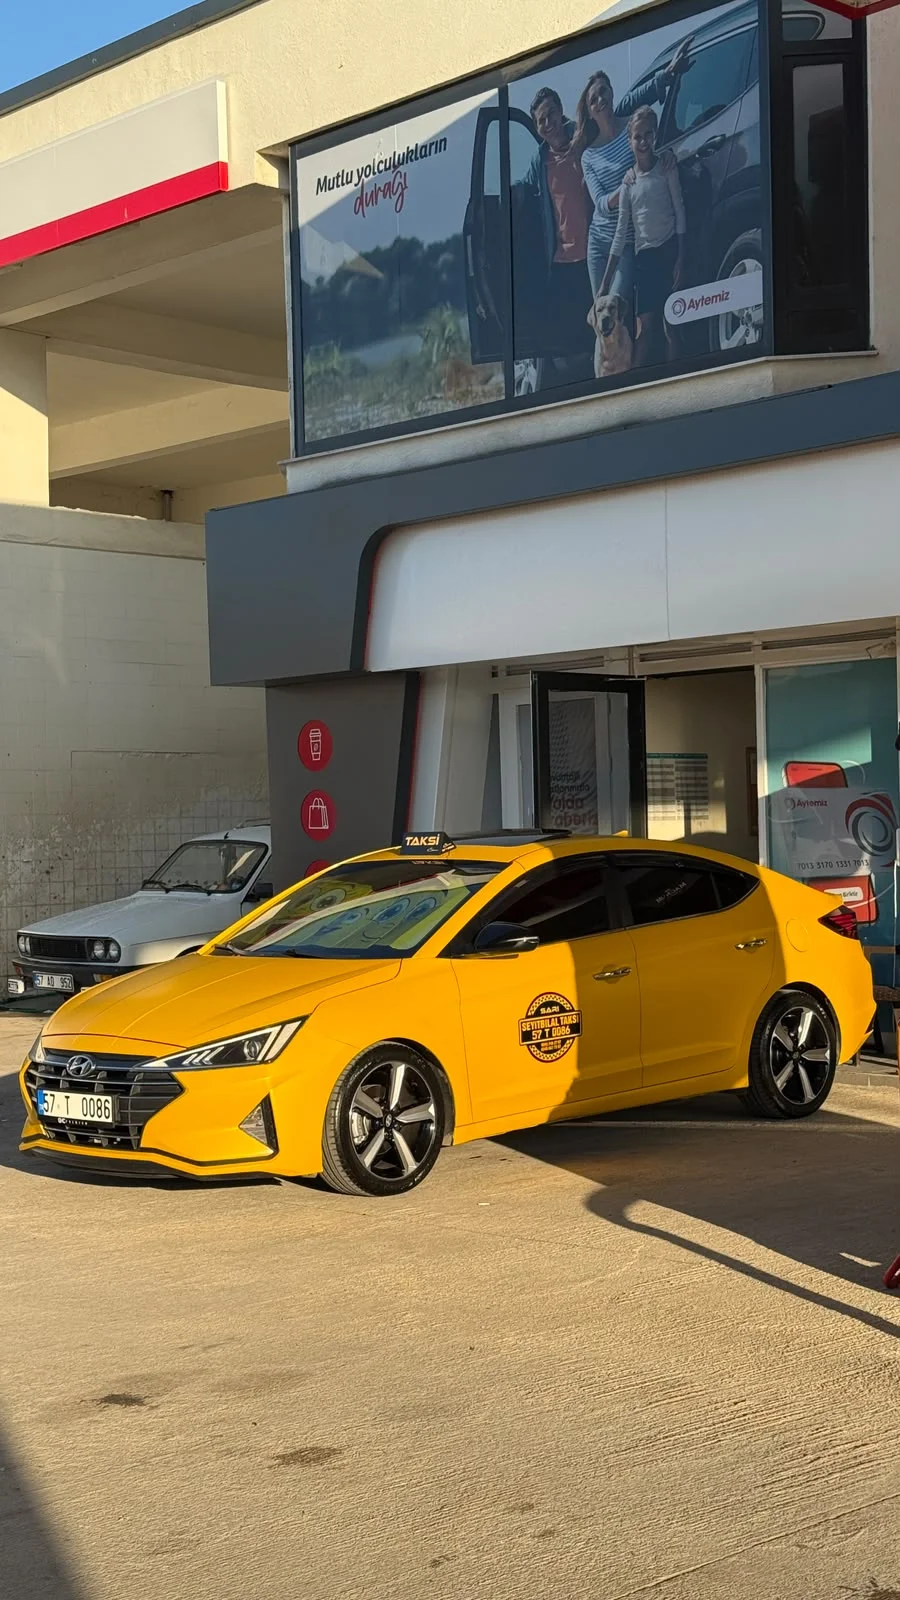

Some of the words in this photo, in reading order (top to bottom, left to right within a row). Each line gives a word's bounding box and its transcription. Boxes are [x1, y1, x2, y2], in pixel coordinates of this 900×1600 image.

[316, 168, 354, 196] Mutlu
[354, 137, 447, 187] yolculukların
[687, 290, 730, 311] Aytemiz
[796, 799, 828, 809] Aytemiz
[405, 833, 440, 846] TAKSİ
[797, 861, 815, 870] 7013
[816, 861, 833, 869] 3170
[835, 860, 851, 868] 1331
[853, 859, 869, 867] 7013
[532, 1030, 542, 1040] 57
[544, 1028, 550, 1038] T
[552, 1025, 571, 1037] 0086
[43, 1093, 55, 1113] 57
[64, 1096, 70, 1115] T
[82, 1097, 111, 1119] 0086
